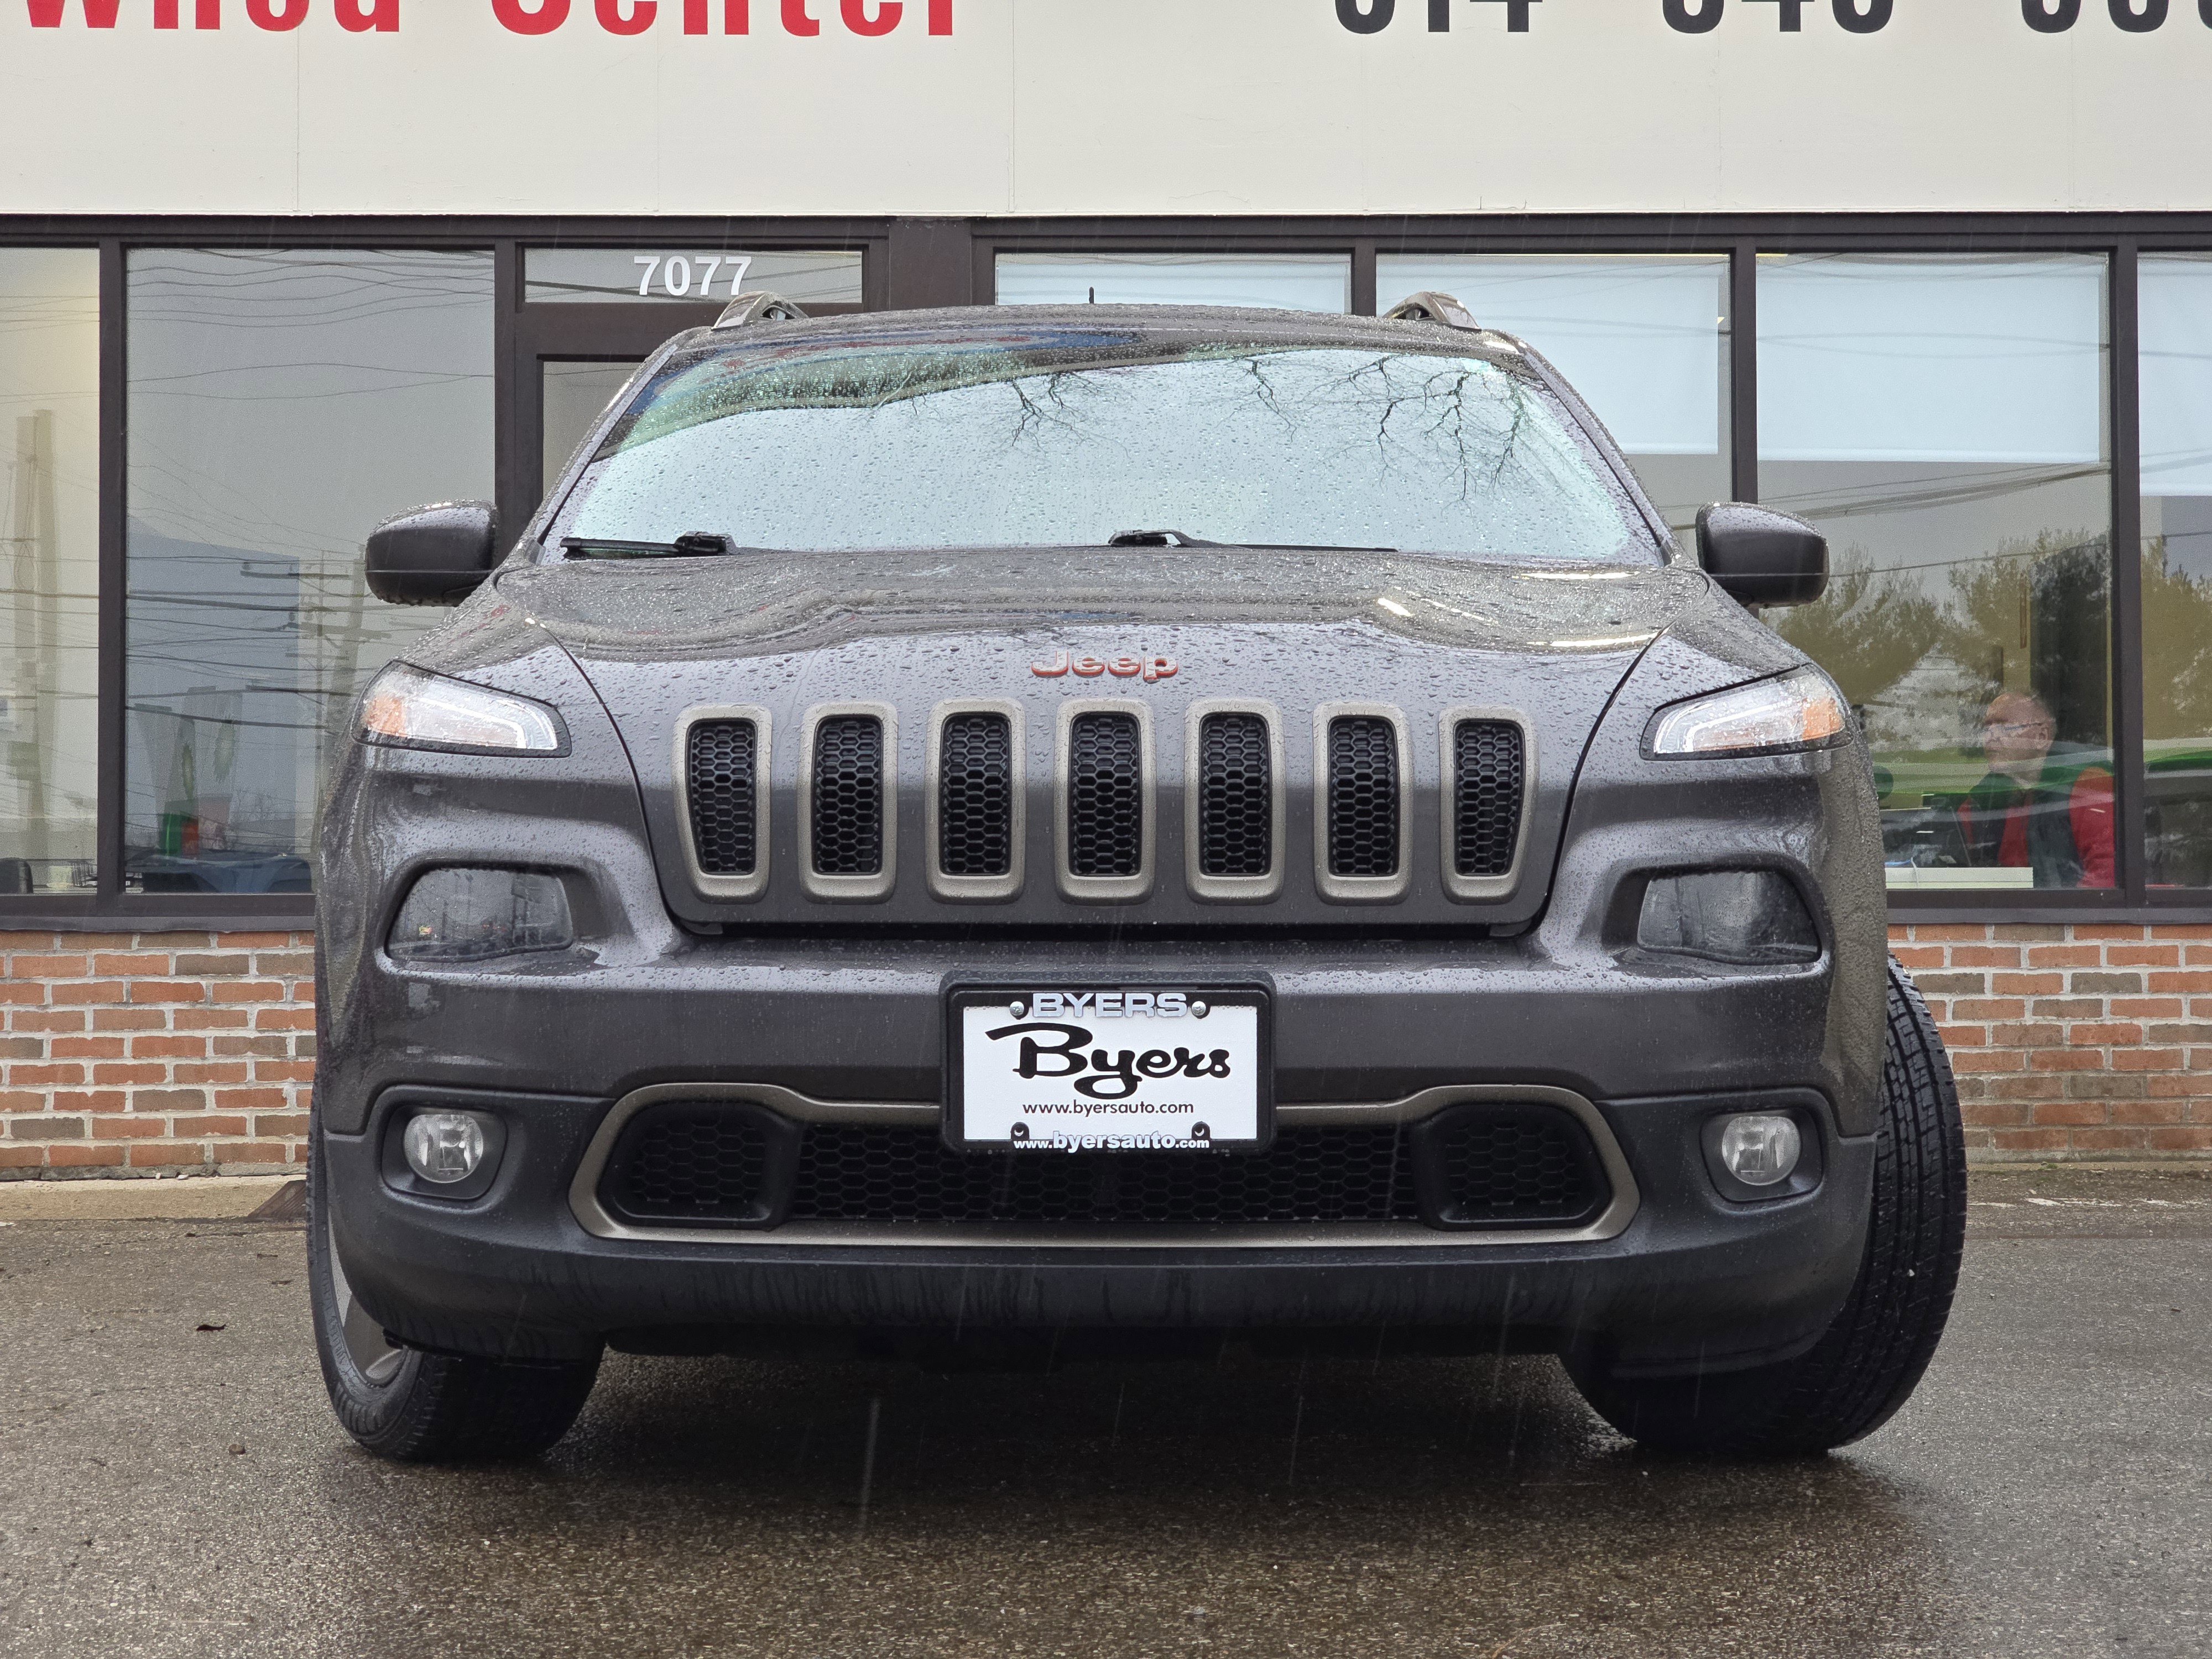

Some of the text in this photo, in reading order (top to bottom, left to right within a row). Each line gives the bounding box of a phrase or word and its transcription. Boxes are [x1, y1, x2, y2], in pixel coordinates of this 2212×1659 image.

[634, 255, 752, 296] 7077
[1031, 650, 1178, 681] Jeep
[1032, 993, 1188, 1018] BYERS
[984, 1022, 1231, 1100] Byers
[1022, 1099, 1194, 1118] www.byersauto.com
[1013, 1130, 1210, 1153] www.byersauto.com
